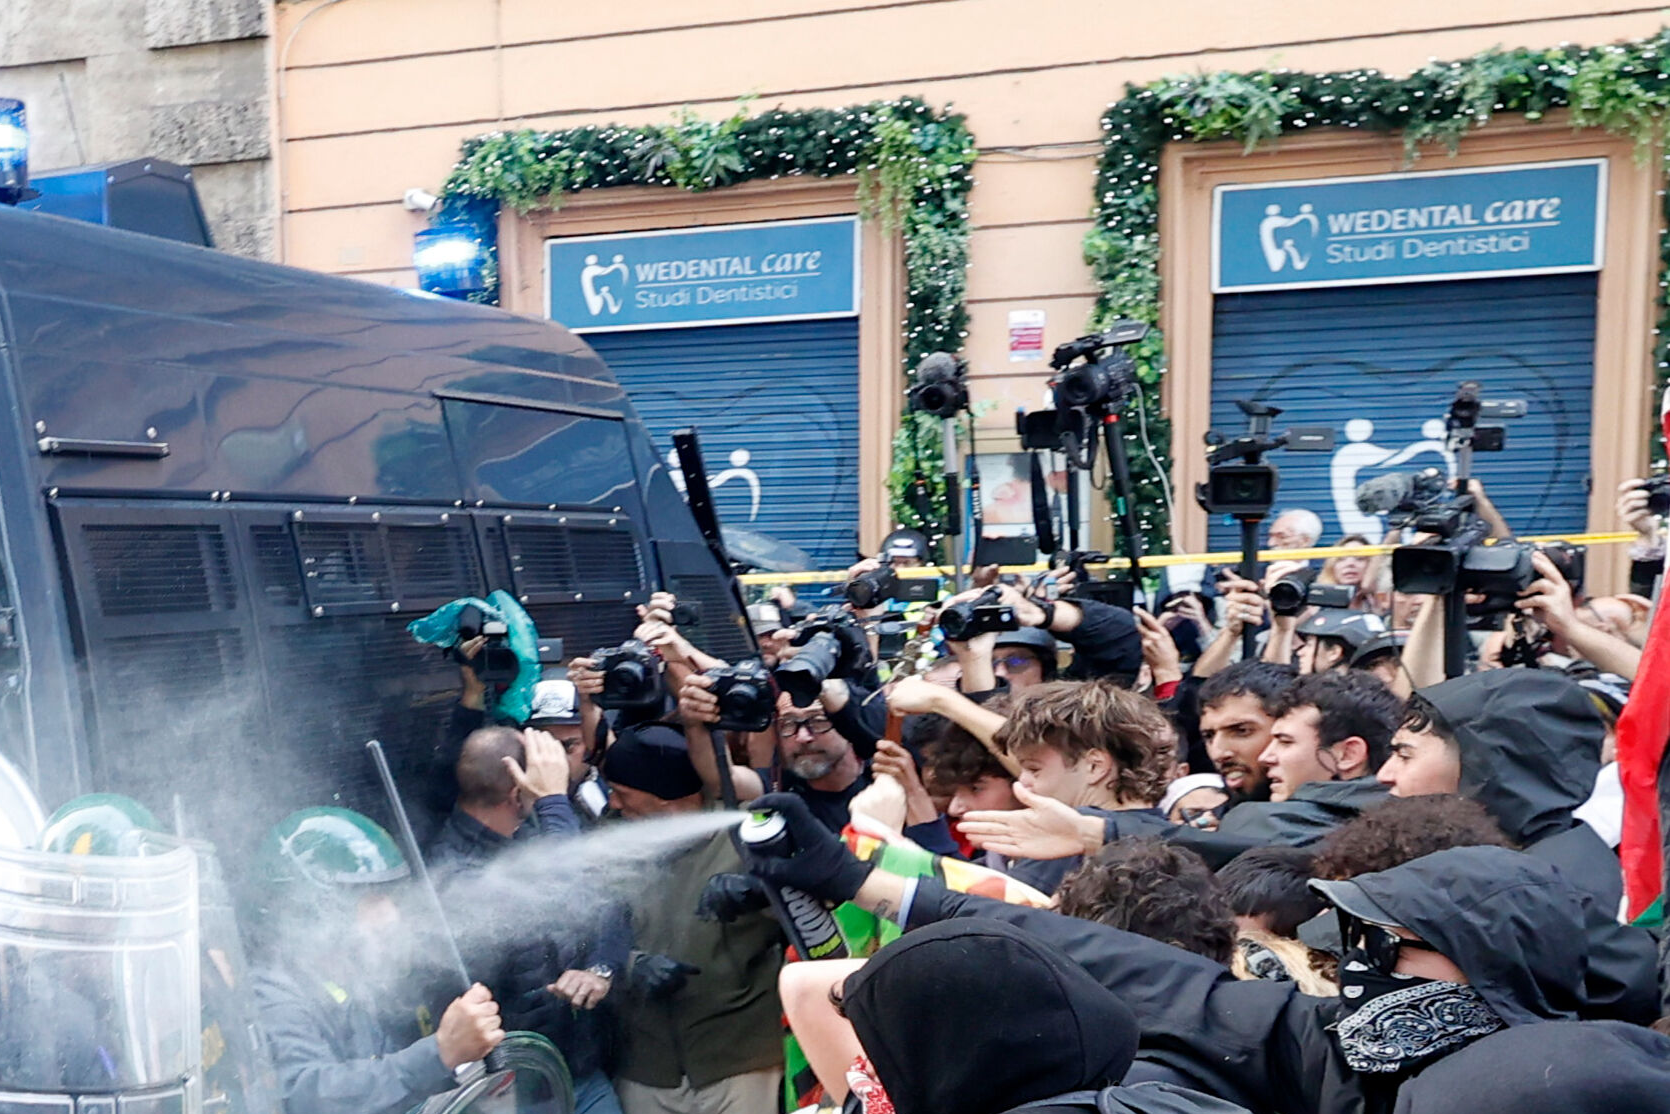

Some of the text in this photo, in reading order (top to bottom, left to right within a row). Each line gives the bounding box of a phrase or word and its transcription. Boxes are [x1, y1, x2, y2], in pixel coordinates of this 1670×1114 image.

[1327, 196, 1562, 234] WEDENTAL care
[1326, 231, 1530, 264] Studi Dentistici
[635, 250, 822, 282] WEDENTAL care
[635, 280, 799, 309] Studi Dentistici
